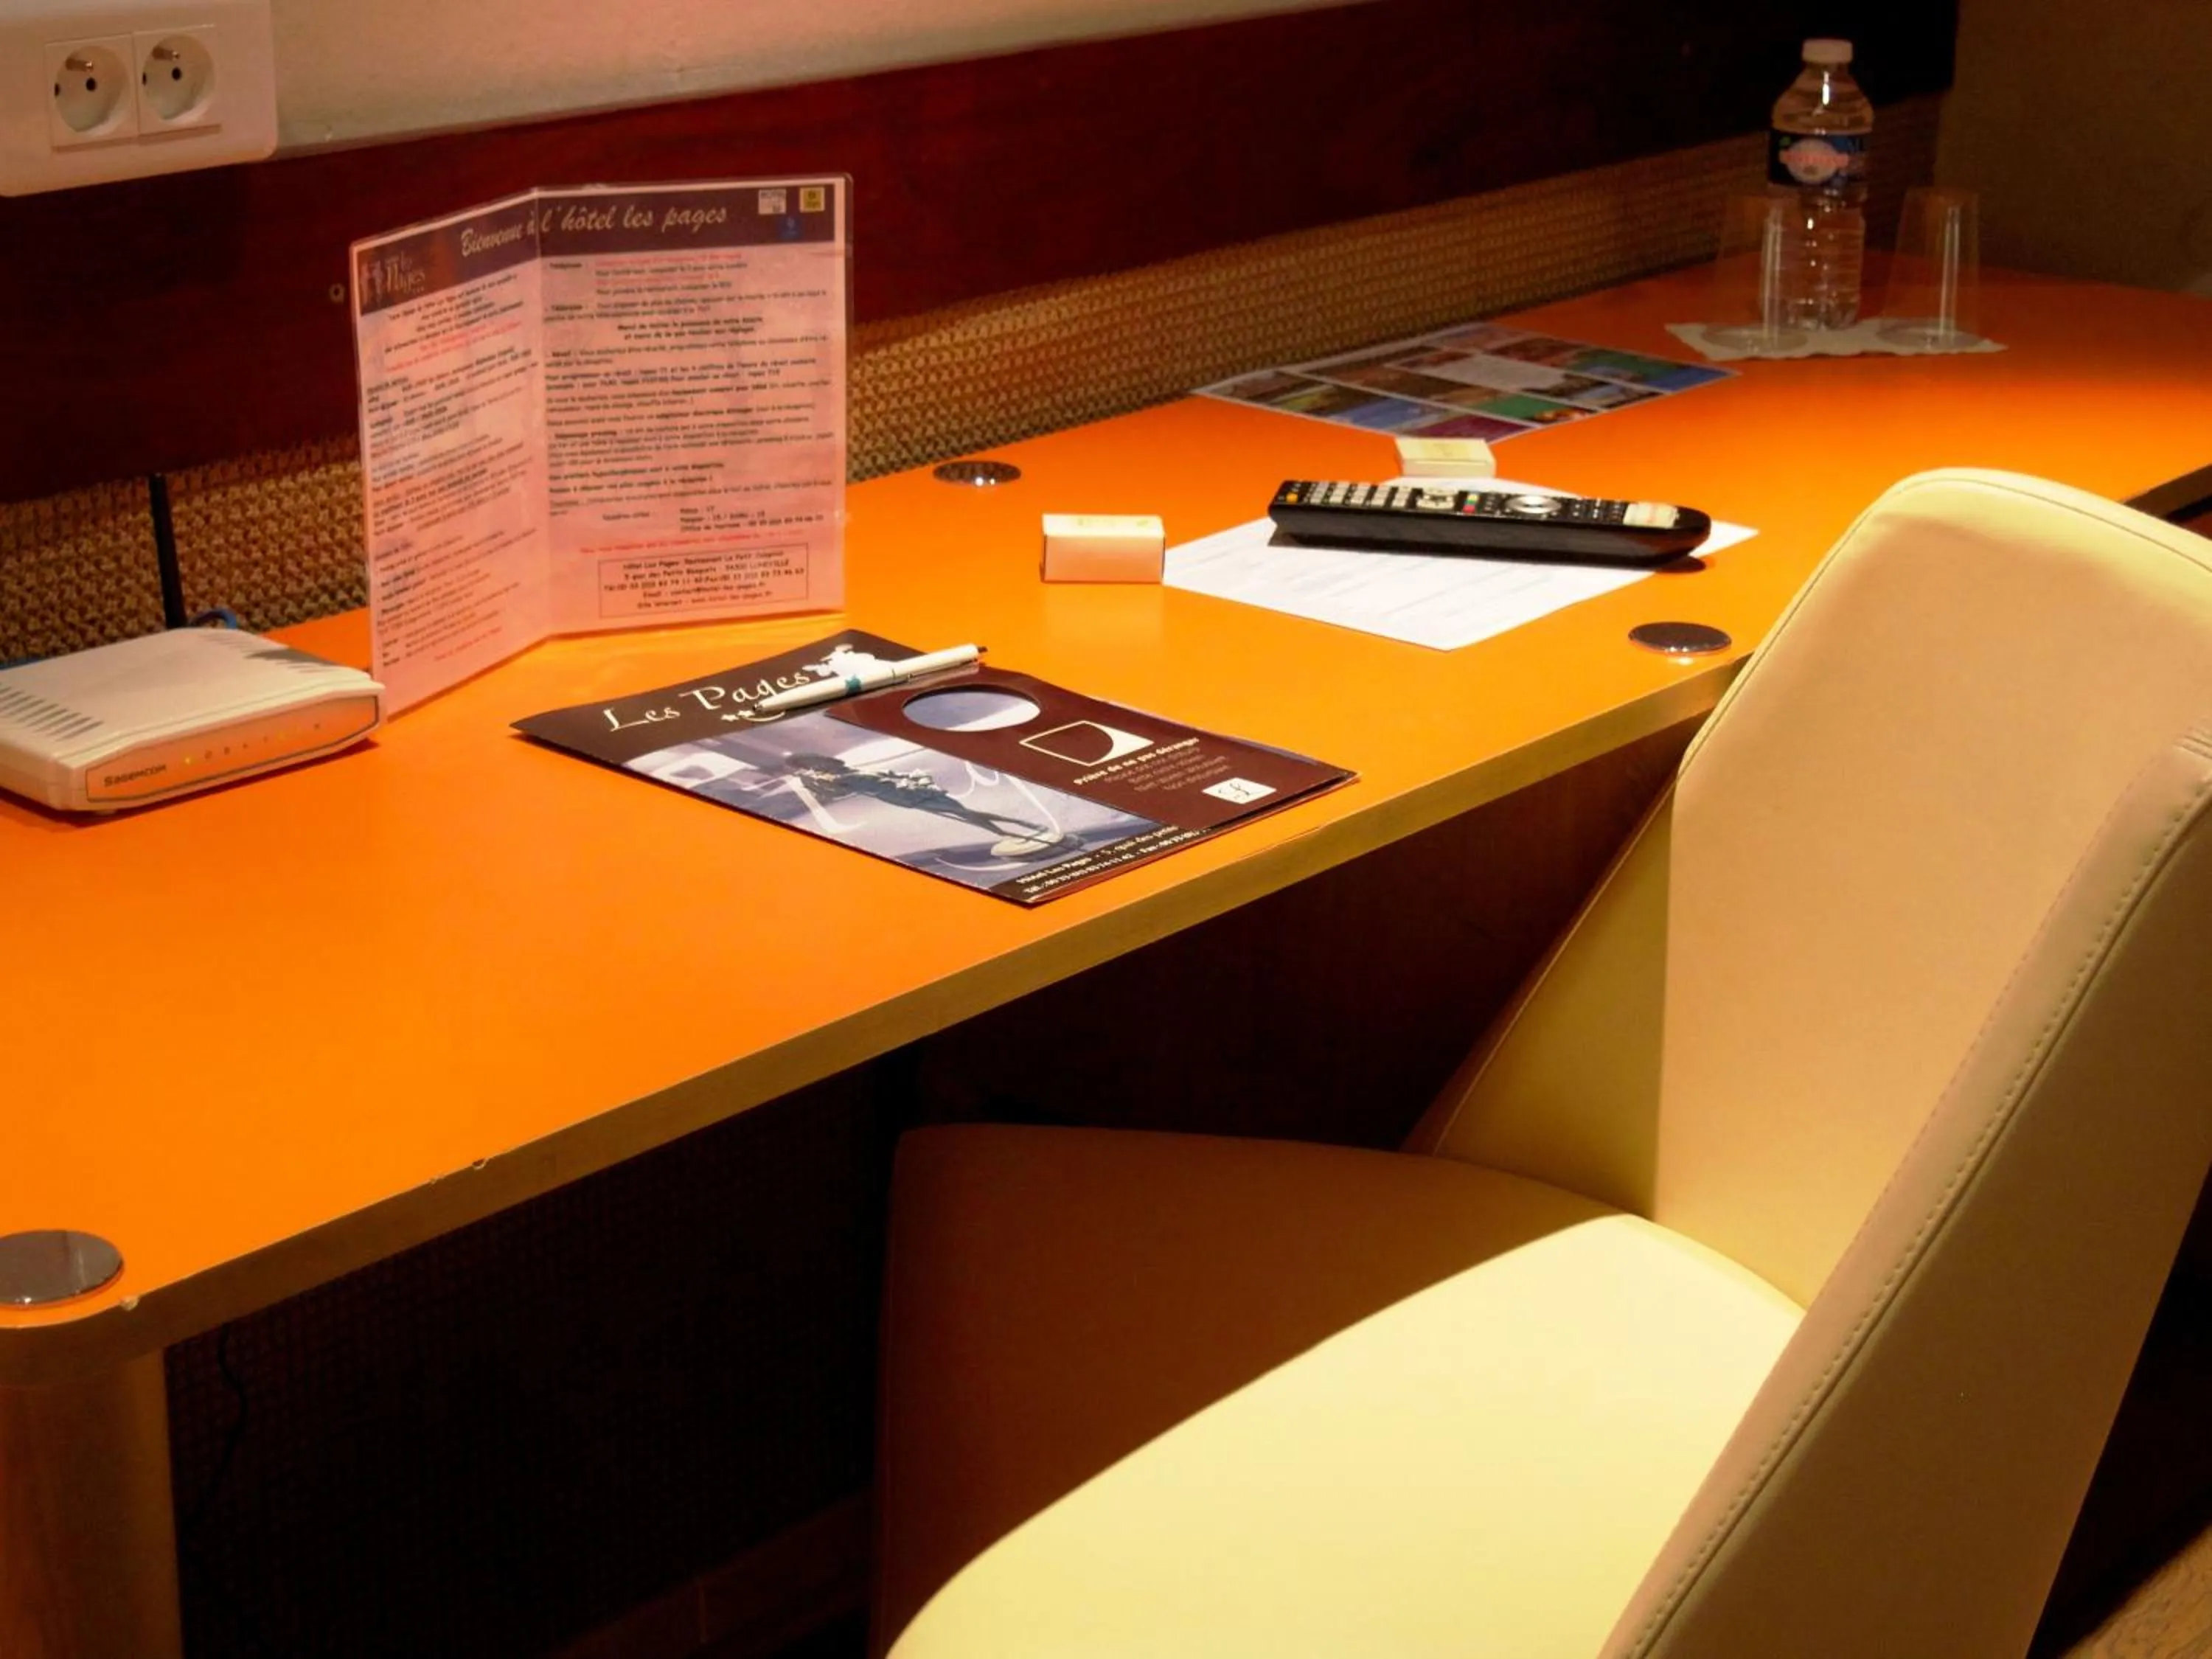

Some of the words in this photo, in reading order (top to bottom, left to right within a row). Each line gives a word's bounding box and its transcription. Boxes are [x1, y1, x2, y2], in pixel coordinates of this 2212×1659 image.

[460, 224, 523, 257] Bienvenue
[623, 204, 653, 229] les
[661, 206, 727, 233] pages
[602, 706, 681, 732] Les
[678, 671, 812, 713] Pages
